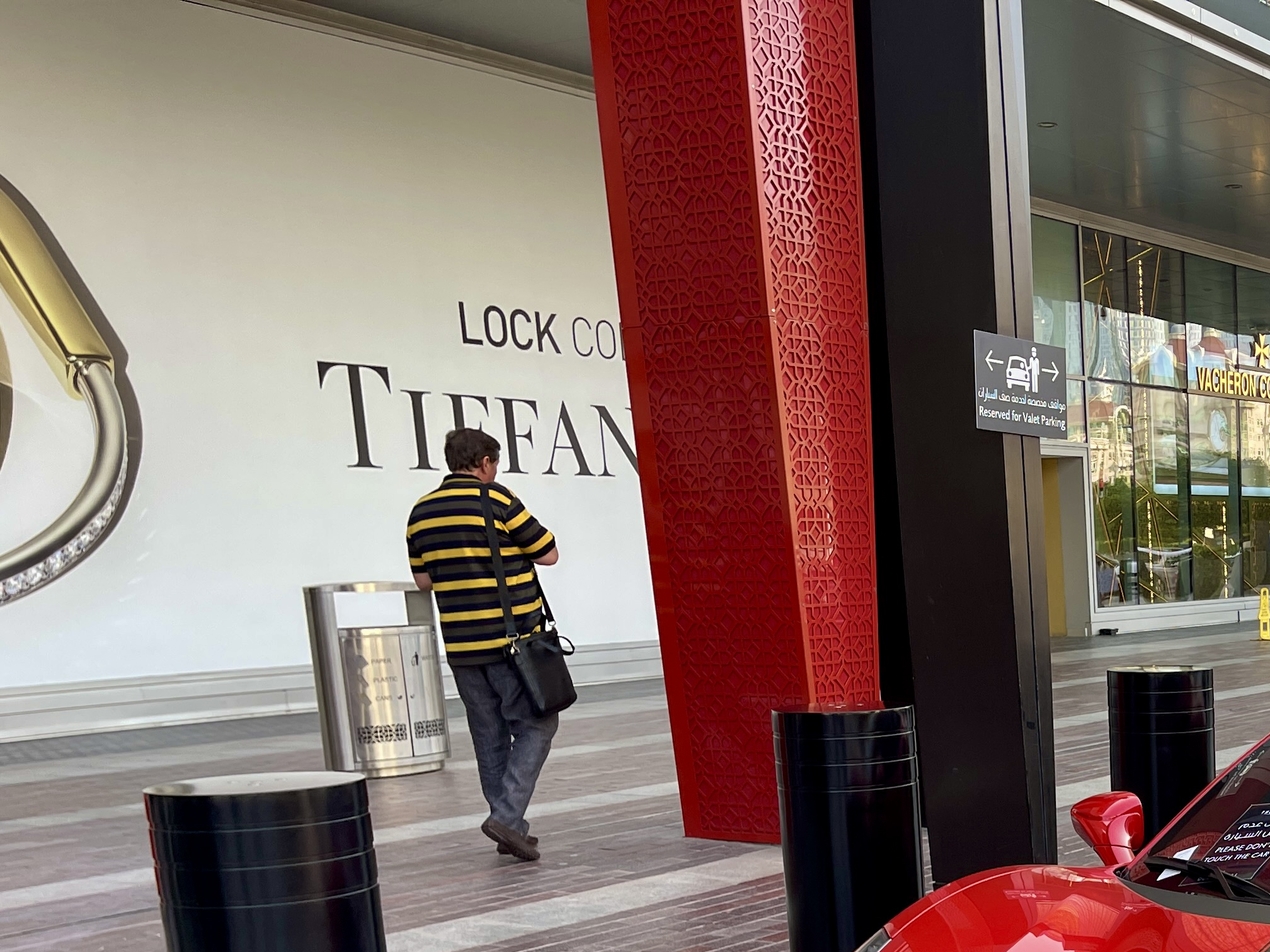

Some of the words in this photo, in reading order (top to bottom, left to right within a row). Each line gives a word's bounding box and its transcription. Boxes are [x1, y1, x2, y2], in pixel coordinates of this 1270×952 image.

[458, 301, 562, 354] LOCK
[572, 316, 626, 361] CO
[1196, 366, 1257, 397] VACHERON
[979, 405, 1011, 420] Reserved
[1011, 410, 1022, 422] for
[1022, 411, 1041, 425] Valet
[1041, 414, 1066, 431] Parking
[1203, 855, 1232, 863] TOUCH
[1214, 844, 1244, 854] PLEASE
